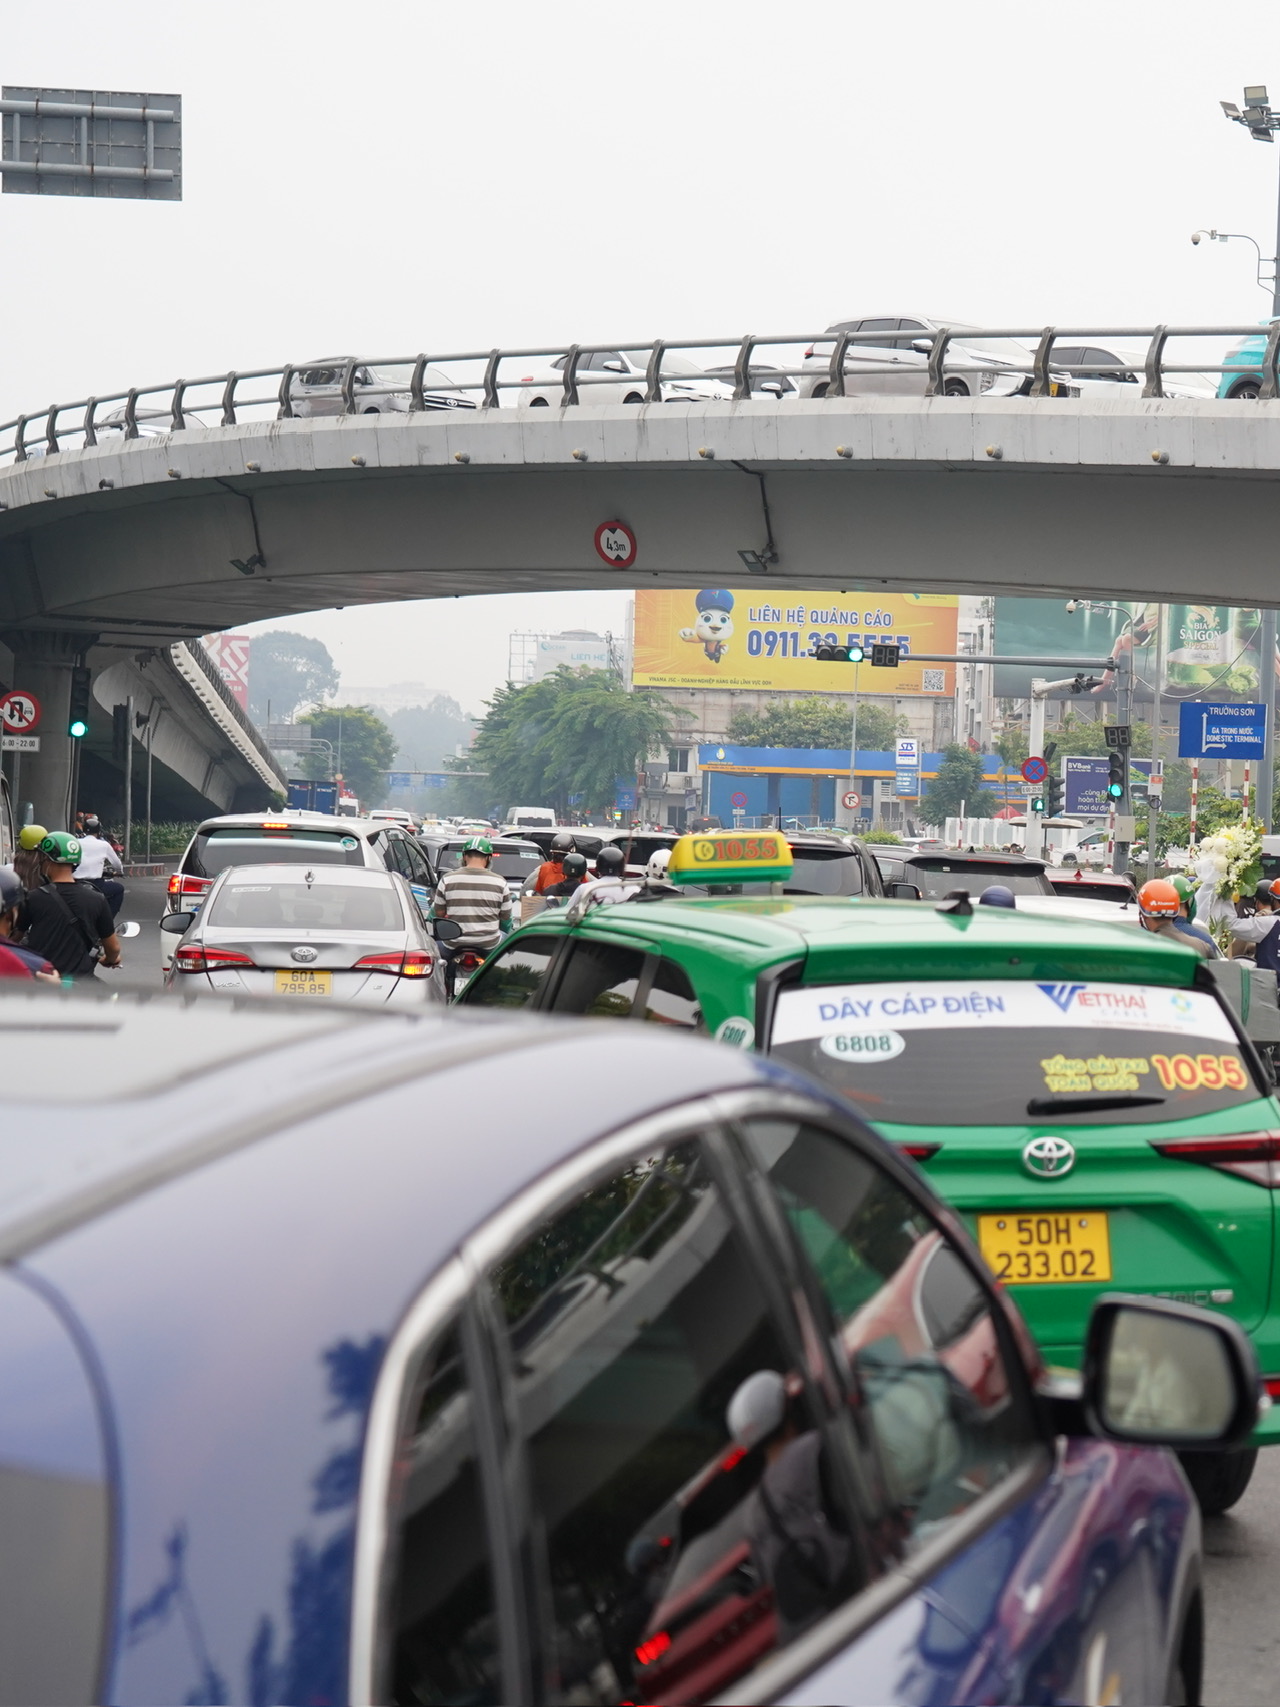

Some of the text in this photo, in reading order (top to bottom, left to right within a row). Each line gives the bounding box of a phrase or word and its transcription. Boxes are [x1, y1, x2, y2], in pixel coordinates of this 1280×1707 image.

[749, 605, 892, 627] LIÊN HỆ QUẢNG CÁO
[1194, 622, 1208, 630] BIA
[1180, 628, 1222, 641] SAIGON
[1183, 641, 1218, 650] SPECIAL
[1210, 705, 1256, 716] TRƯỜNG SƠN
[1211, 726, 1220, 734] GA
[1221, 727, 1238, 735] TRONG
[1207, 734, 1262, 744] DOMESTIC TERMINAL
[714, 838, 778, 860] 1055
[291, 970, 315, 983] 60A
[280, 983, 326, 995] 795.85
[819, 990, 1006, 1022] DÂY CÁP ĐIỆN
[835, 1035, 892, 1053] 6808
[1152, 1055, 1247, 1089] 1055
[1017, 1217, 1072, 1245] 50H
[996, 1249, 1097, 1280] 233.02
